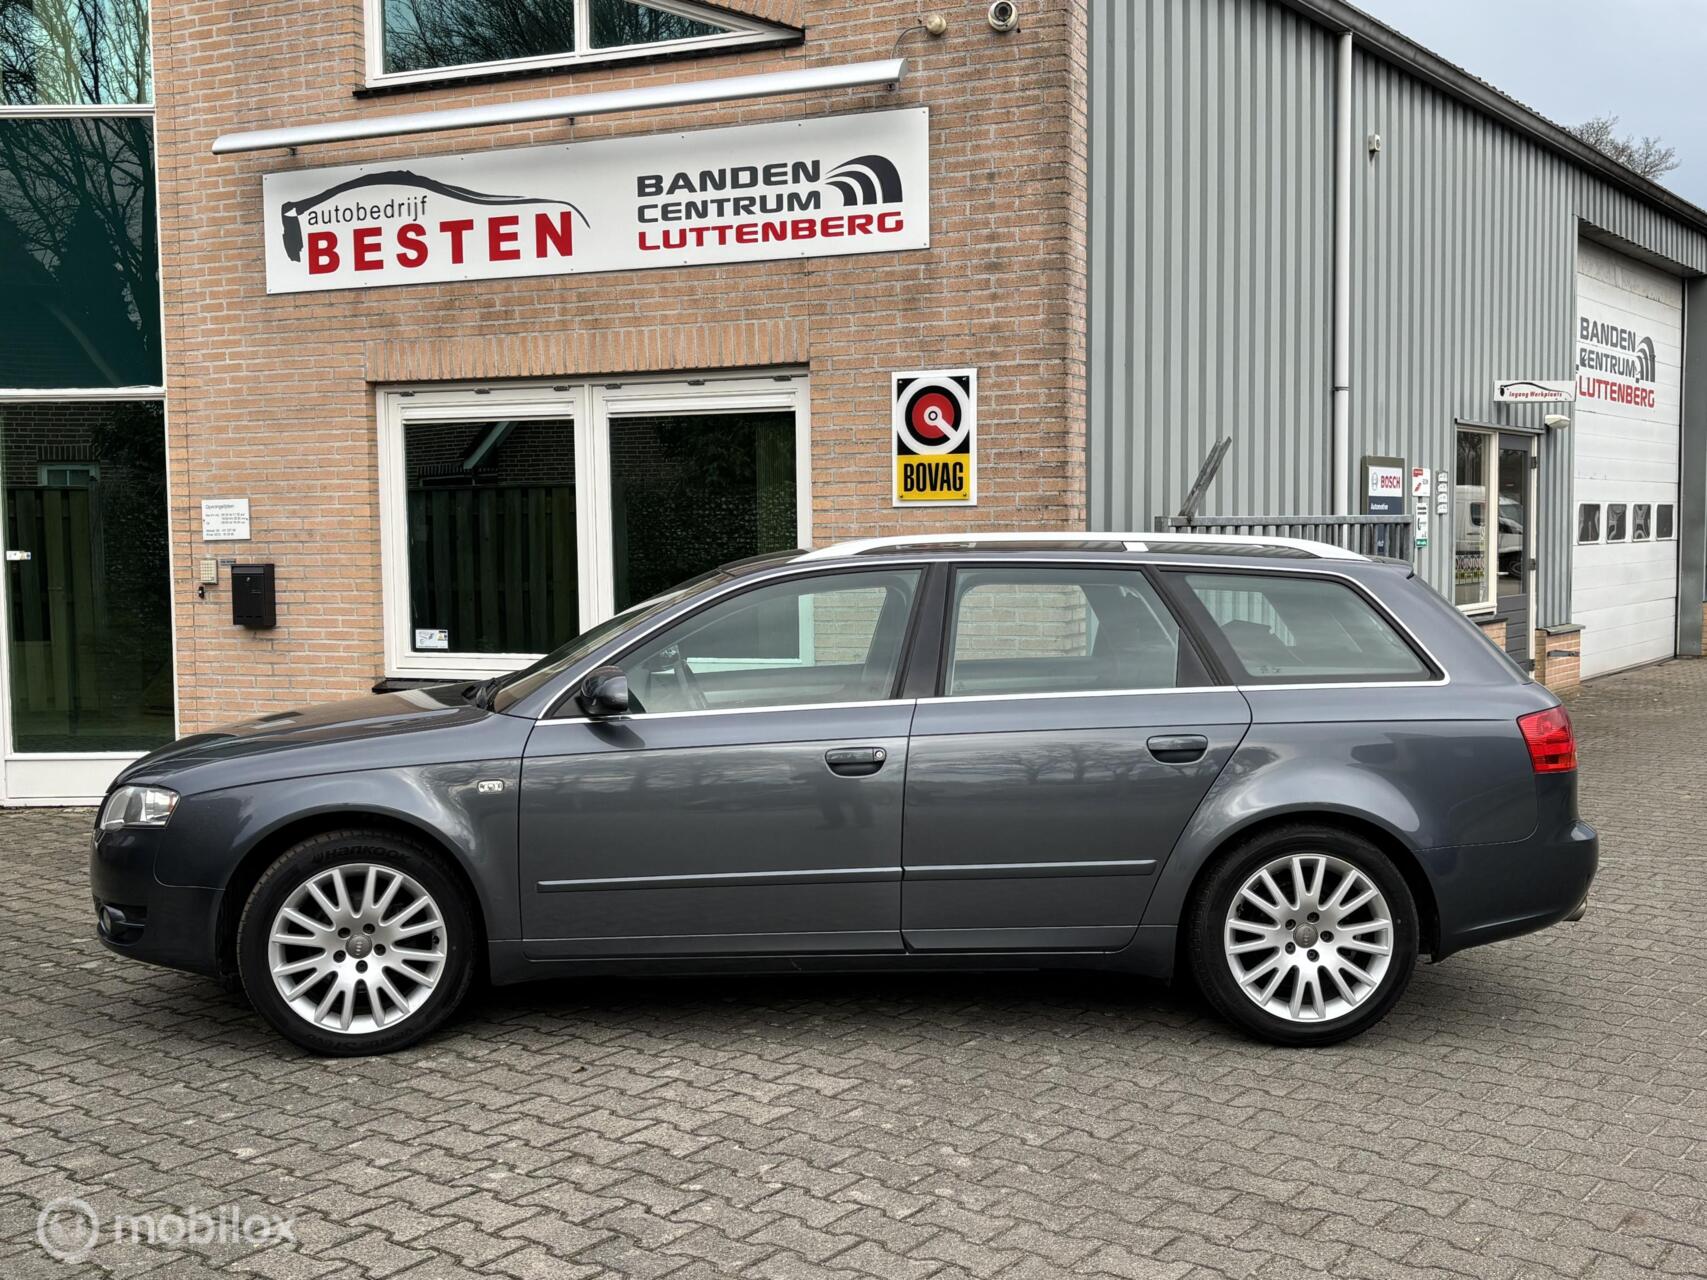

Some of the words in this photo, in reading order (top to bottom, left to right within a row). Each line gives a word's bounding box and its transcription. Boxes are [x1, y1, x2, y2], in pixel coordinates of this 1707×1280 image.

[636, 159, 820, 197] BANDEN
[307, 195, 427, 226] autobedrijf
[637, 190, 821, 224] CENTRUM
[307, 211, 573, 275] BESTEN
[638, 211, 904, 250] LUTTENBERG
[1580, 316, 1636, 352] BANDEN
[1579, 347, 1636, 378] CENTRUM
[1578, 375, 1655, 408] LUTTENBERG
[903, 461, 964, 492] BOVAG
[1380, 475, 1401, 488] BOSCH
